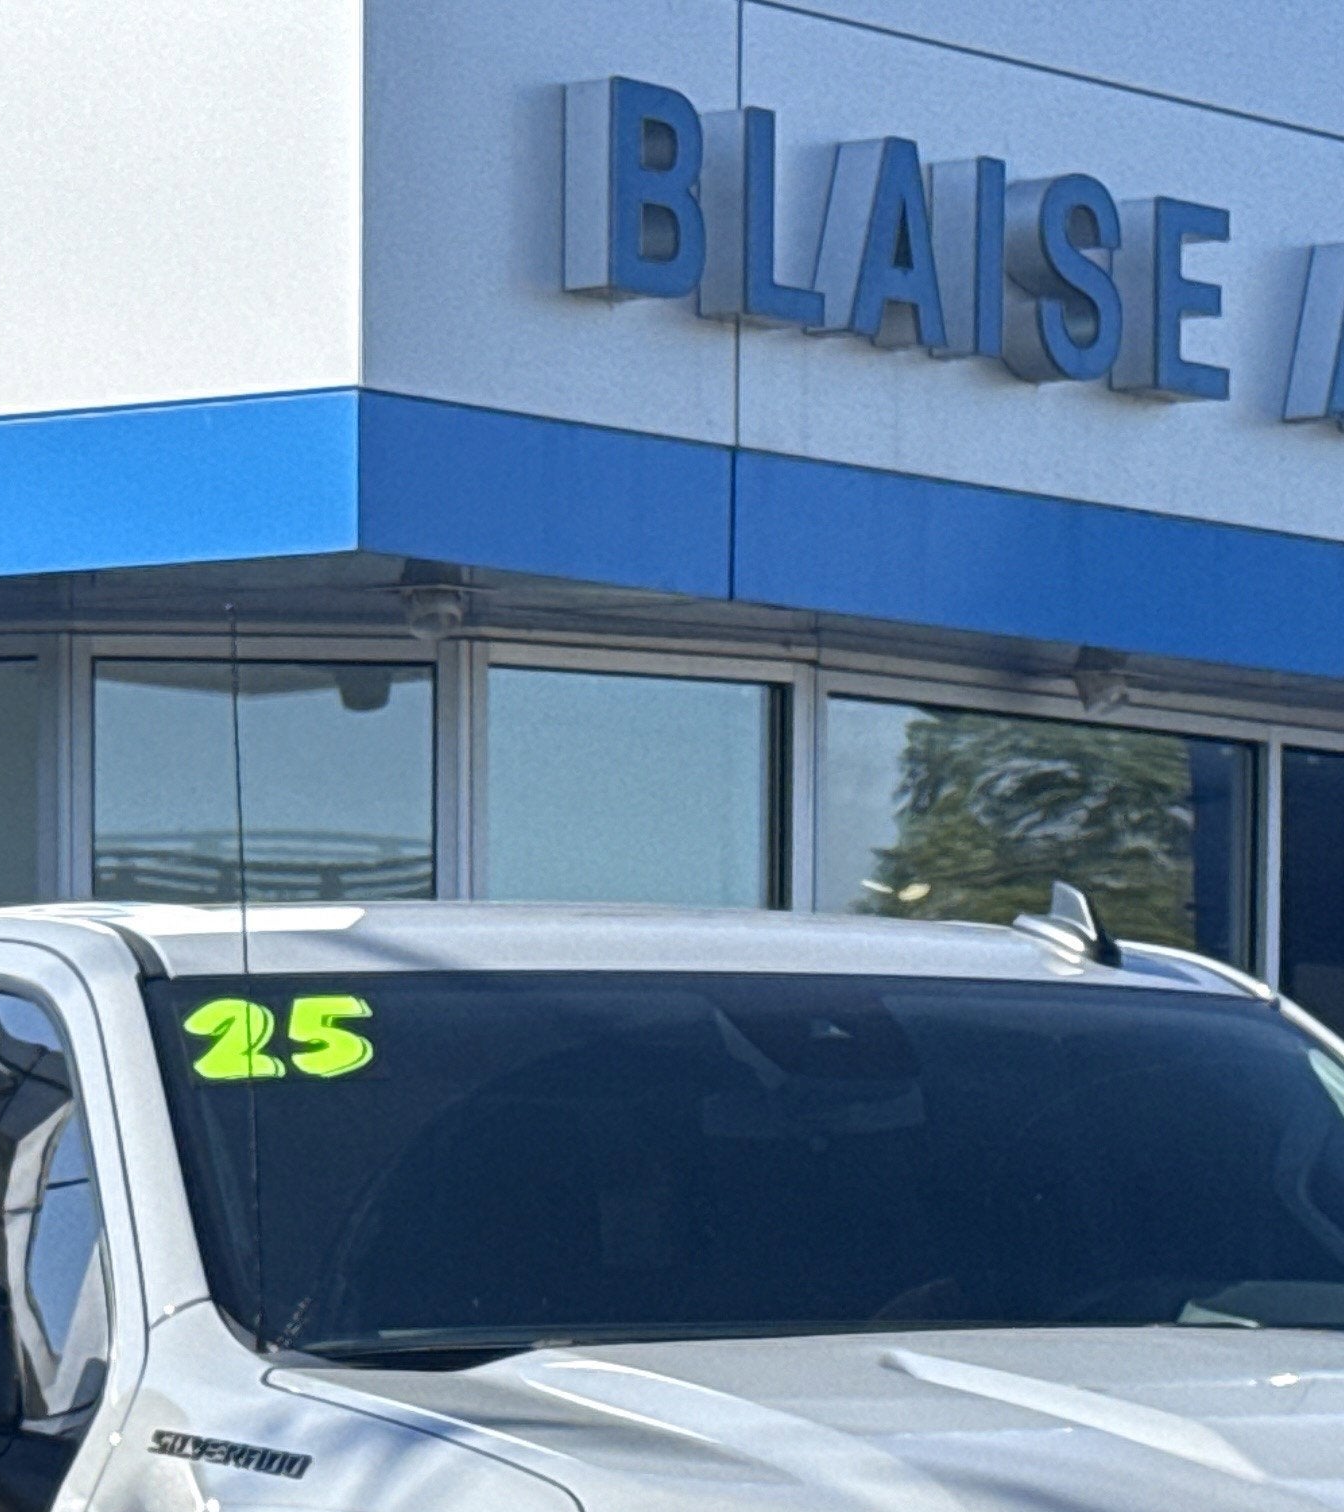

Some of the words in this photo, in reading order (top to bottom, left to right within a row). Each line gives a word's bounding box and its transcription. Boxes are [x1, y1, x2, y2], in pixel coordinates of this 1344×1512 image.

[606, 75, 1231, 402] BLAISE
[184, 995, 374, 1079] 25
[146, 1429, 313, 1481] SILVERADO
